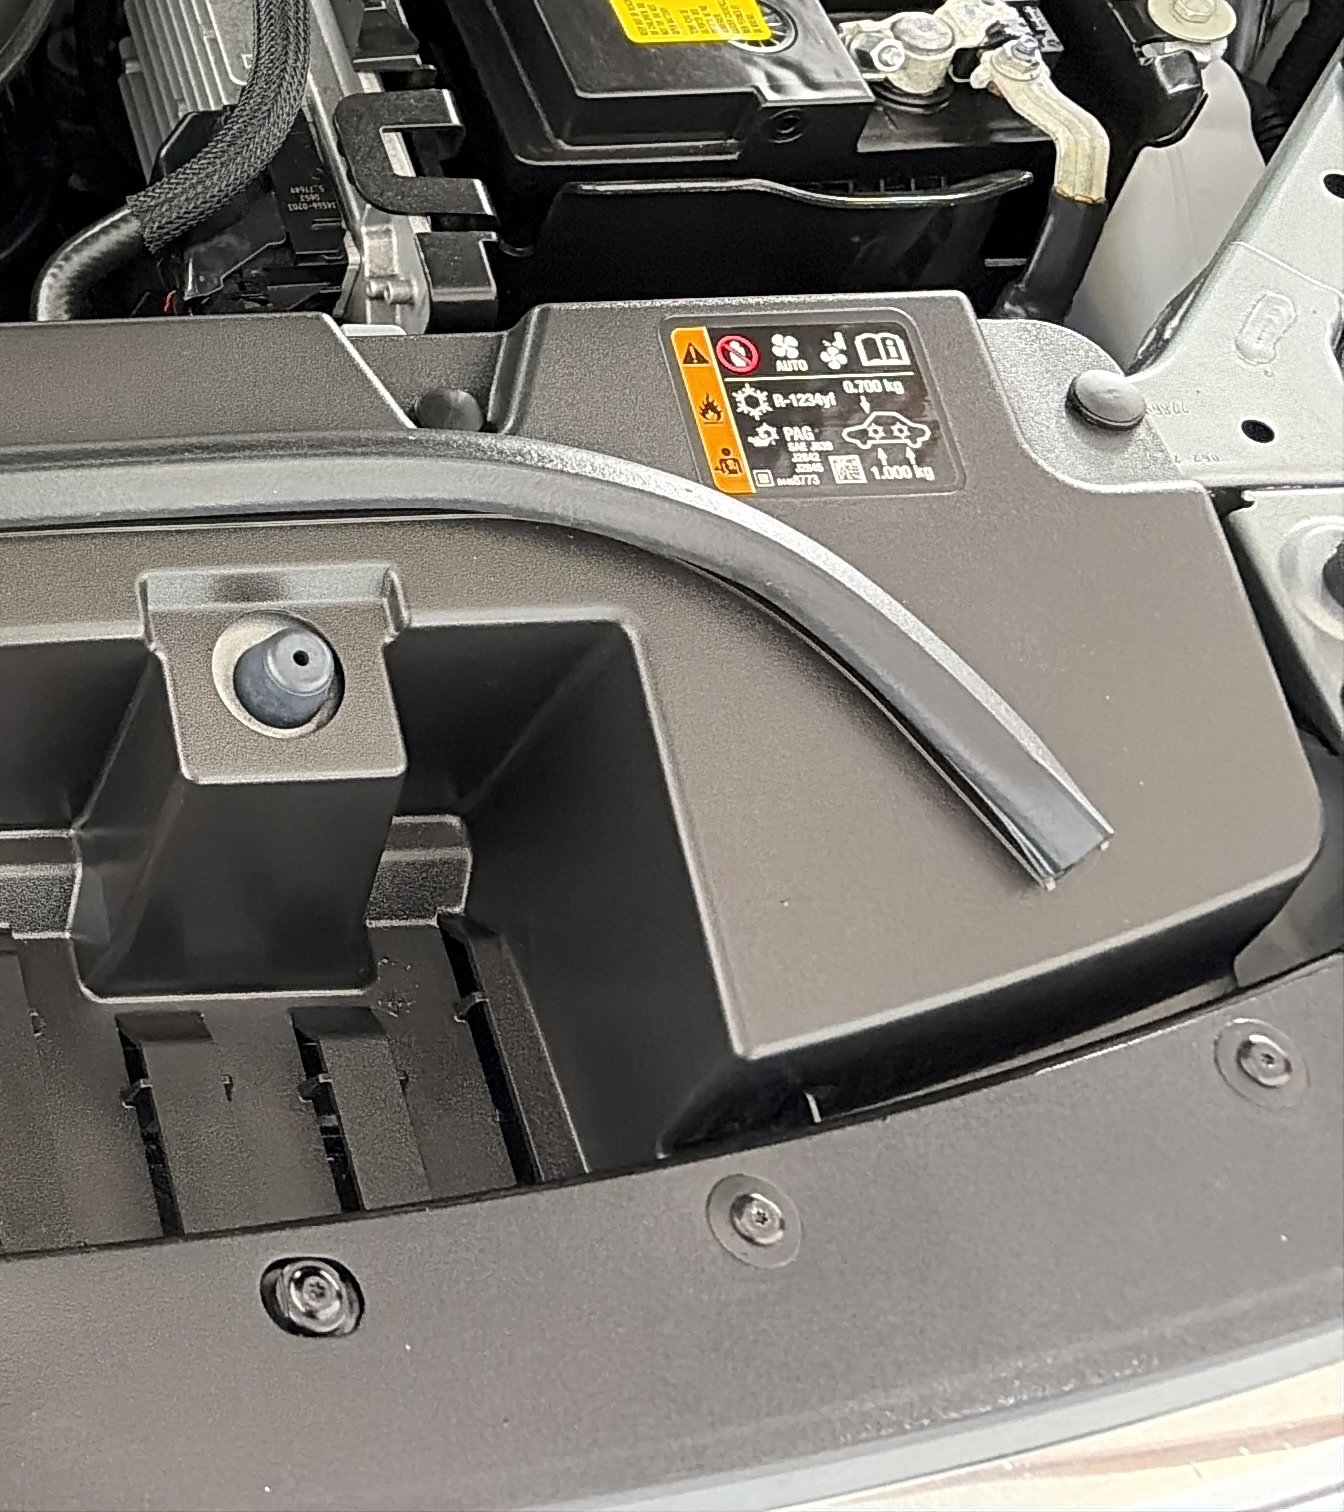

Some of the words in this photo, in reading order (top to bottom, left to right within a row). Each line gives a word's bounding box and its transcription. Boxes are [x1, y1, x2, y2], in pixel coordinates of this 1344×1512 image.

[776, 360, 809, 372] AUTO
[842, 380, 883, 394] 0.700
[884, 378, 905, 395] kg
[772, 391, 837, 409] R-1234yf
[782, 425, 815, 442] PAG
[870, 465, 913, 480] 1.000
[914, 464, 935, 481] kg
